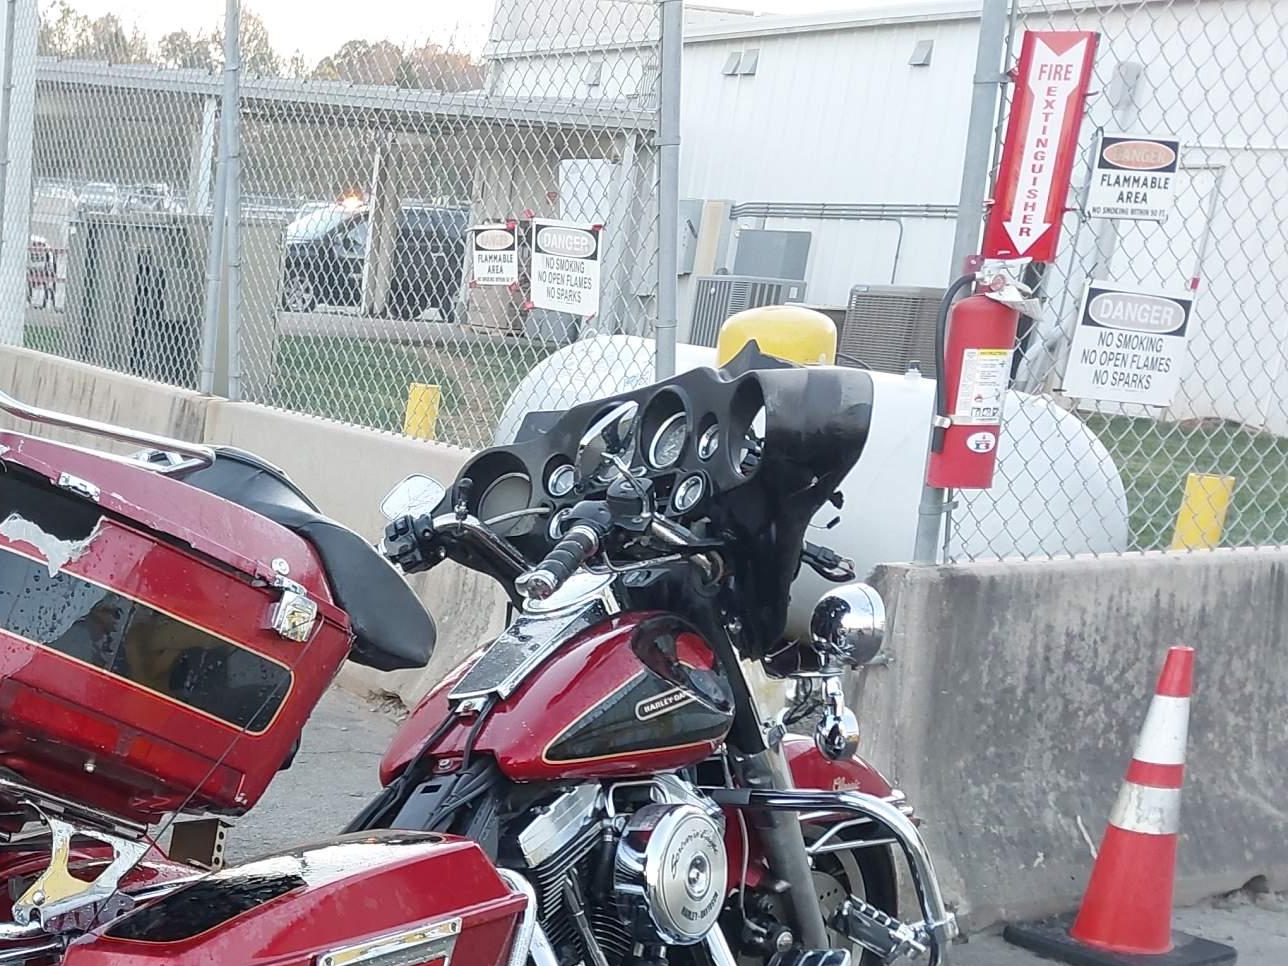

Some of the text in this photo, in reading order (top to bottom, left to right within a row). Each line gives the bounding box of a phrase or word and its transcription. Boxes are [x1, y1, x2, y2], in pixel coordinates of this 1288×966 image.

[1038, 64, 1074, 81] FIRE
[1019, 86, 1057, 237] EXTINGUISHER
[1100, 173, 1170, 190] FLAMMABLE
[1116, 190, 1148, 204] AREA
[543, 233, 588, 252] DANGER
[477, 254, 514, 264] FLAMMABLE
[545, 257, 585, 274] NO SMOKING
[487, 264, 503, 275] AREA
[538, 270, 592, 290] NO OPEN FLAMES
[546, 286, 582, 303] NO SPARKS
[1100, 299, 1175, 326] DANGER
[1097, 331, 1163, 353] NO SMOKING
[1080, 348, 1172, 373] NO OPEN FLAMES
[1092, 369, 1152, 390] NO SPARKS
